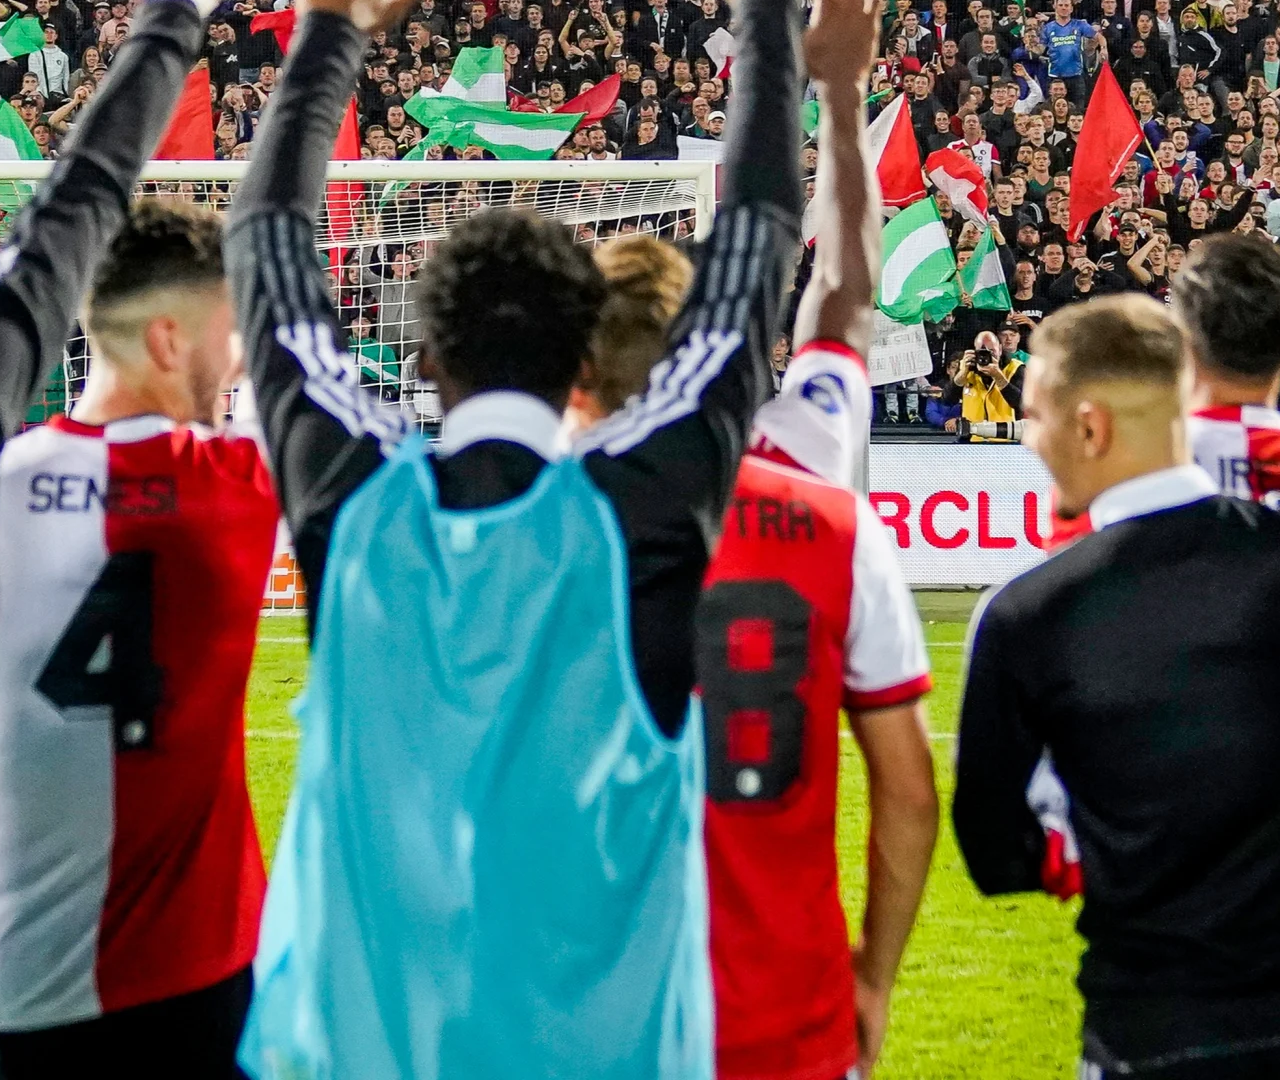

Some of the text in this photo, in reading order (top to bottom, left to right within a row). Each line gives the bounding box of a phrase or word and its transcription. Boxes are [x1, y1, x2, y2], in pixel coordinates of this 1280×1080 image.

[28, 473, 180, 514] SENESI
[33, 551, 164, 753] 4
[694, 580, 814, 805] 8
